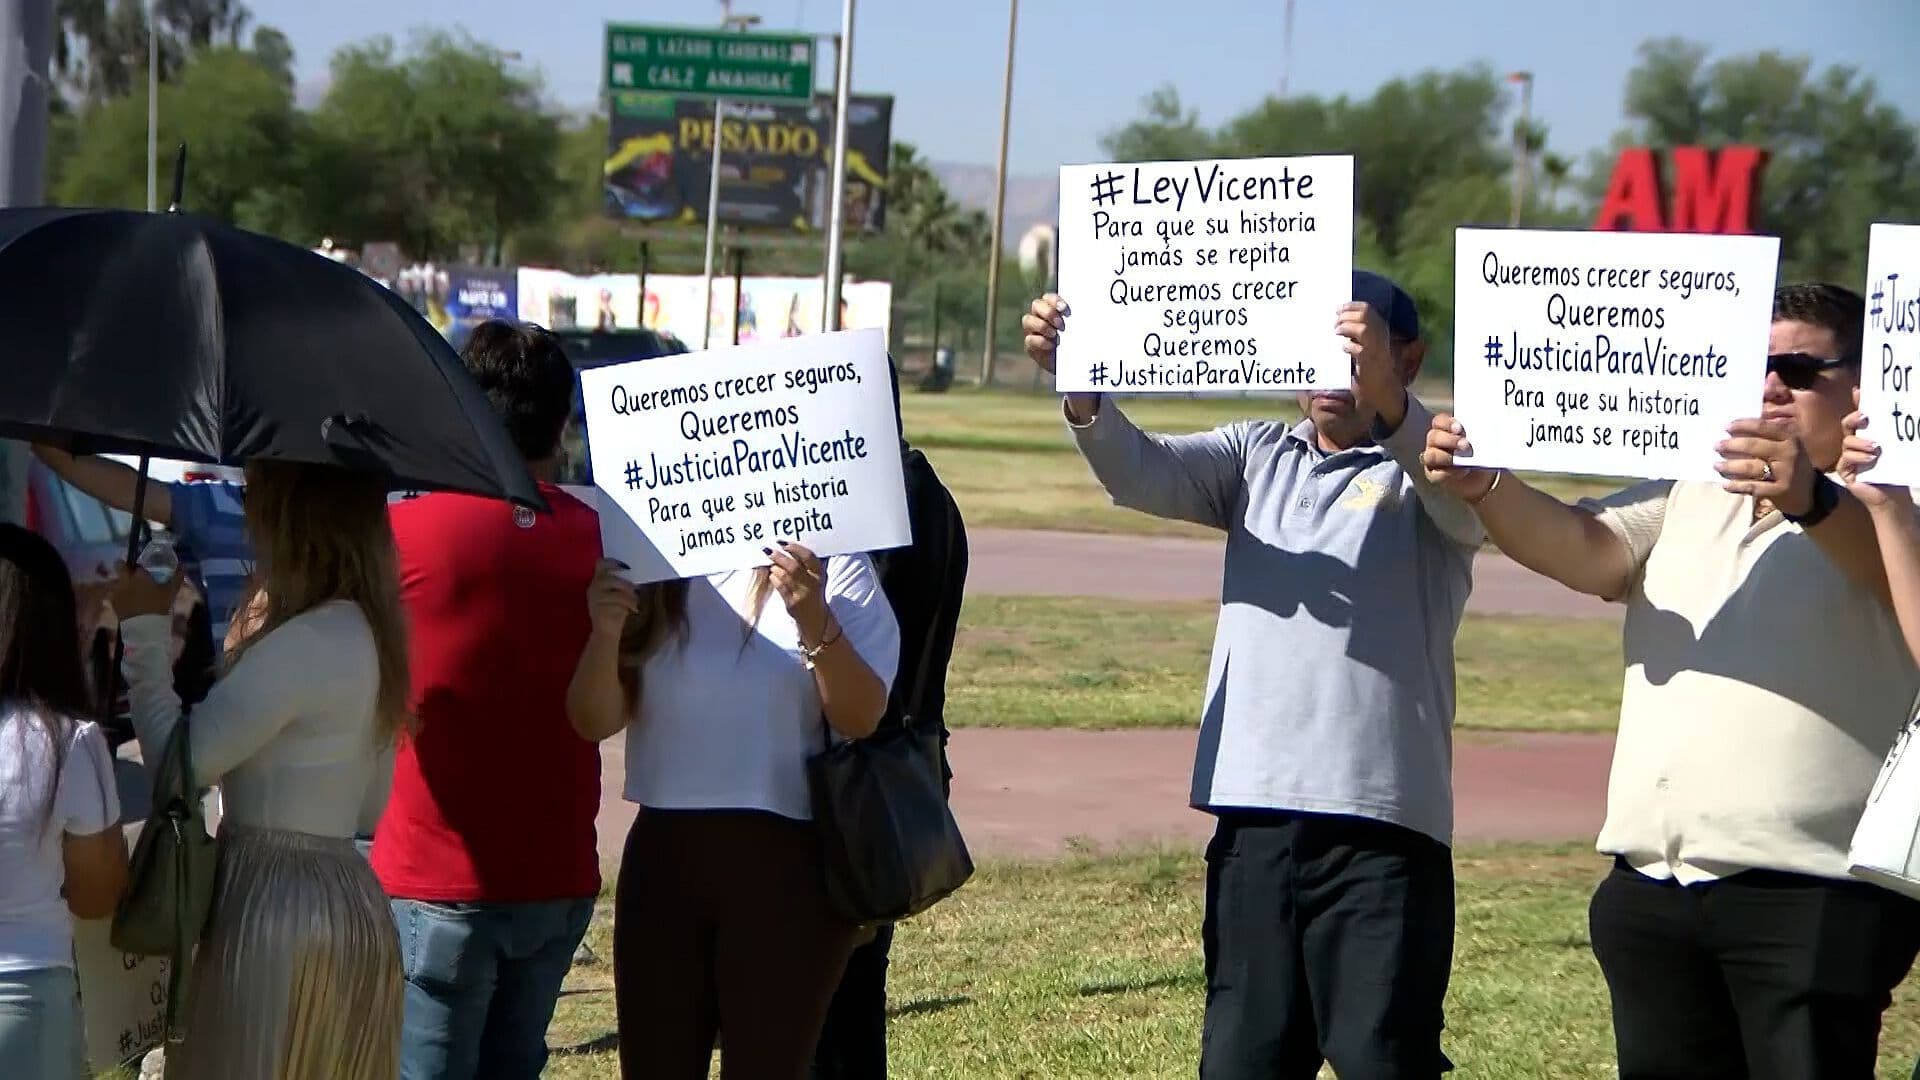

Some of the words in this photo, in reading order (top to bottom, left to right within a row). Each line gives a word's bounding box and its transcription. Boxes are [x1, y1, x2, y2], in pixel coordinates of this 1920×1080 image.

[648, 65, 694, 86] CALZ
[706, 69, 793, 90] ANAHUAC
[679, 118, 818, 156] PESADO
[1596, 146, 1765, 234] AM
[1093, 212, 1143, 239] Para
[1157, 217, 1195, 244] que
[1206, 217, 1229, 234] su
[1241, 210, 1316, 233] historia
[1114, 244, 1183, 275] jamás
[1196, 247, 1218, 264] se
[1229, 241, 1290, 271] repita
[1482, 251, 1580, 287] Queremos
[1587, 266, 1652, 288] crecer
[1658, 267, 1741, 299] seguros,
[1110, 279, 1221, 304] Queremos
[1233, 279, 1298, 299] crecer
[1163, 307, 1248, 334] seguros
[1547, 293, 1665, 329] Queremos
[1144, 333, 1257, 357] Queremos
[1484, 331, 1728, 378] #JusticiaParaVicente
[1089, 360, 1316, 386] #JusticiaParaVicente
[1882, 343, 1912, 391] Por
[611, 382, 709, 416] Queremos
[714, 372, 776, 400] crecer
[785, 361, 862, 394] seguros,
[1504, 379, 1544, 408] Para
[1556, 390, 1589, 417] que
[1599, 393, 1618, 411] su
[1629, 386, 1699, 416] historia
[680, 404, 799, 442] Queremos
[1526, 417, 1584, 448] jamas
[1593, 425, 1612, 446] se
[1623, 424, 1679, 455] repita
[624, 429, 867, 490] #JusticiaParaVicente
[648, 496, 692, 523] Para
[702, 493, 736, 521] que
[744, 486, 765, 510] su
[773, 476, 849, 504] historia
[679, 523, 735, 556] jamas
[744, 522, 764, 541] se
[772, 508, 833, 541] repita
